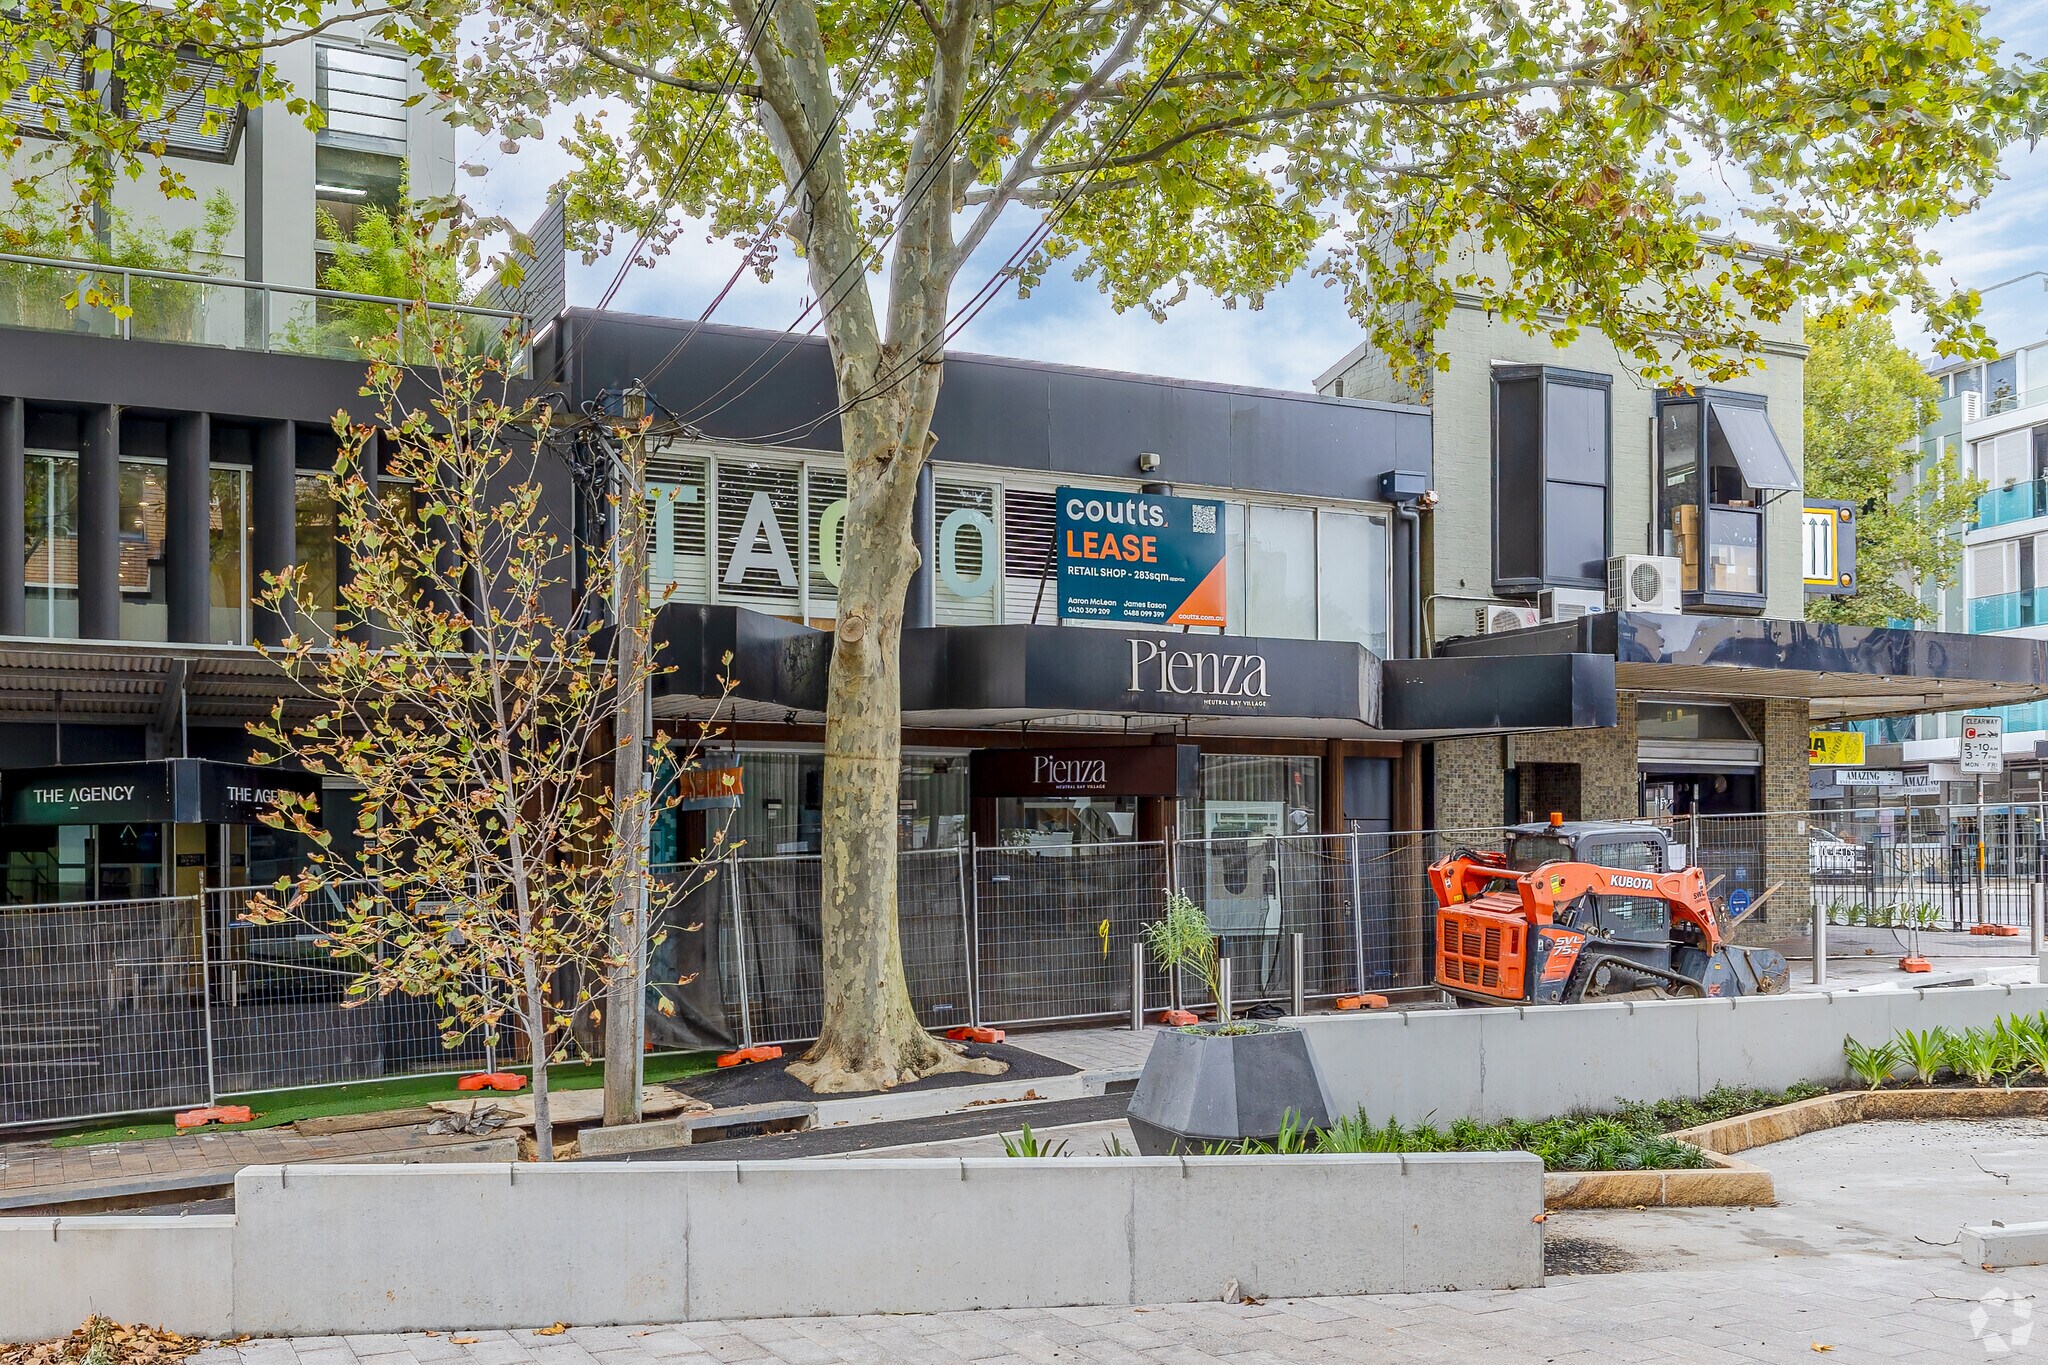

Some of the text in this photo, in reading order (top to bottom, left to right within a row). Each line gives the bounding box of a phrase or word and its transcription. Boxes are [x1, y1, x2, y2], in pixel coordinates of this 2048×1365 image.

[1066, 498, 1164, 528] coutts
[1066, 530, 1158, 562] LEASE
[1068, 566, 1100, 576] RETAIL
[1100, 568, 1126, 578] SHOP
[1134, 570, 1169, 582] 283sqm
[1068, 597, 1117, 607] Aaron McLean
[1124, 600, 1167, 610] James Eason
[1178, 614, 1224, 622] coutts.com.au
[1126, 638, 1272, 697] Pienza
[1810, 738, 1826, 752] A
[1032, 755, 1107, 783] Pienza
[1846, 772, 1880, 780] AMAZING
[34, 786, 135, 803] THE AGENCY
[227, 786, 252, 802] THE
[1610, 874, 1653, 890] KUBOTA
[1554, 936, 1582, 946] SVL
